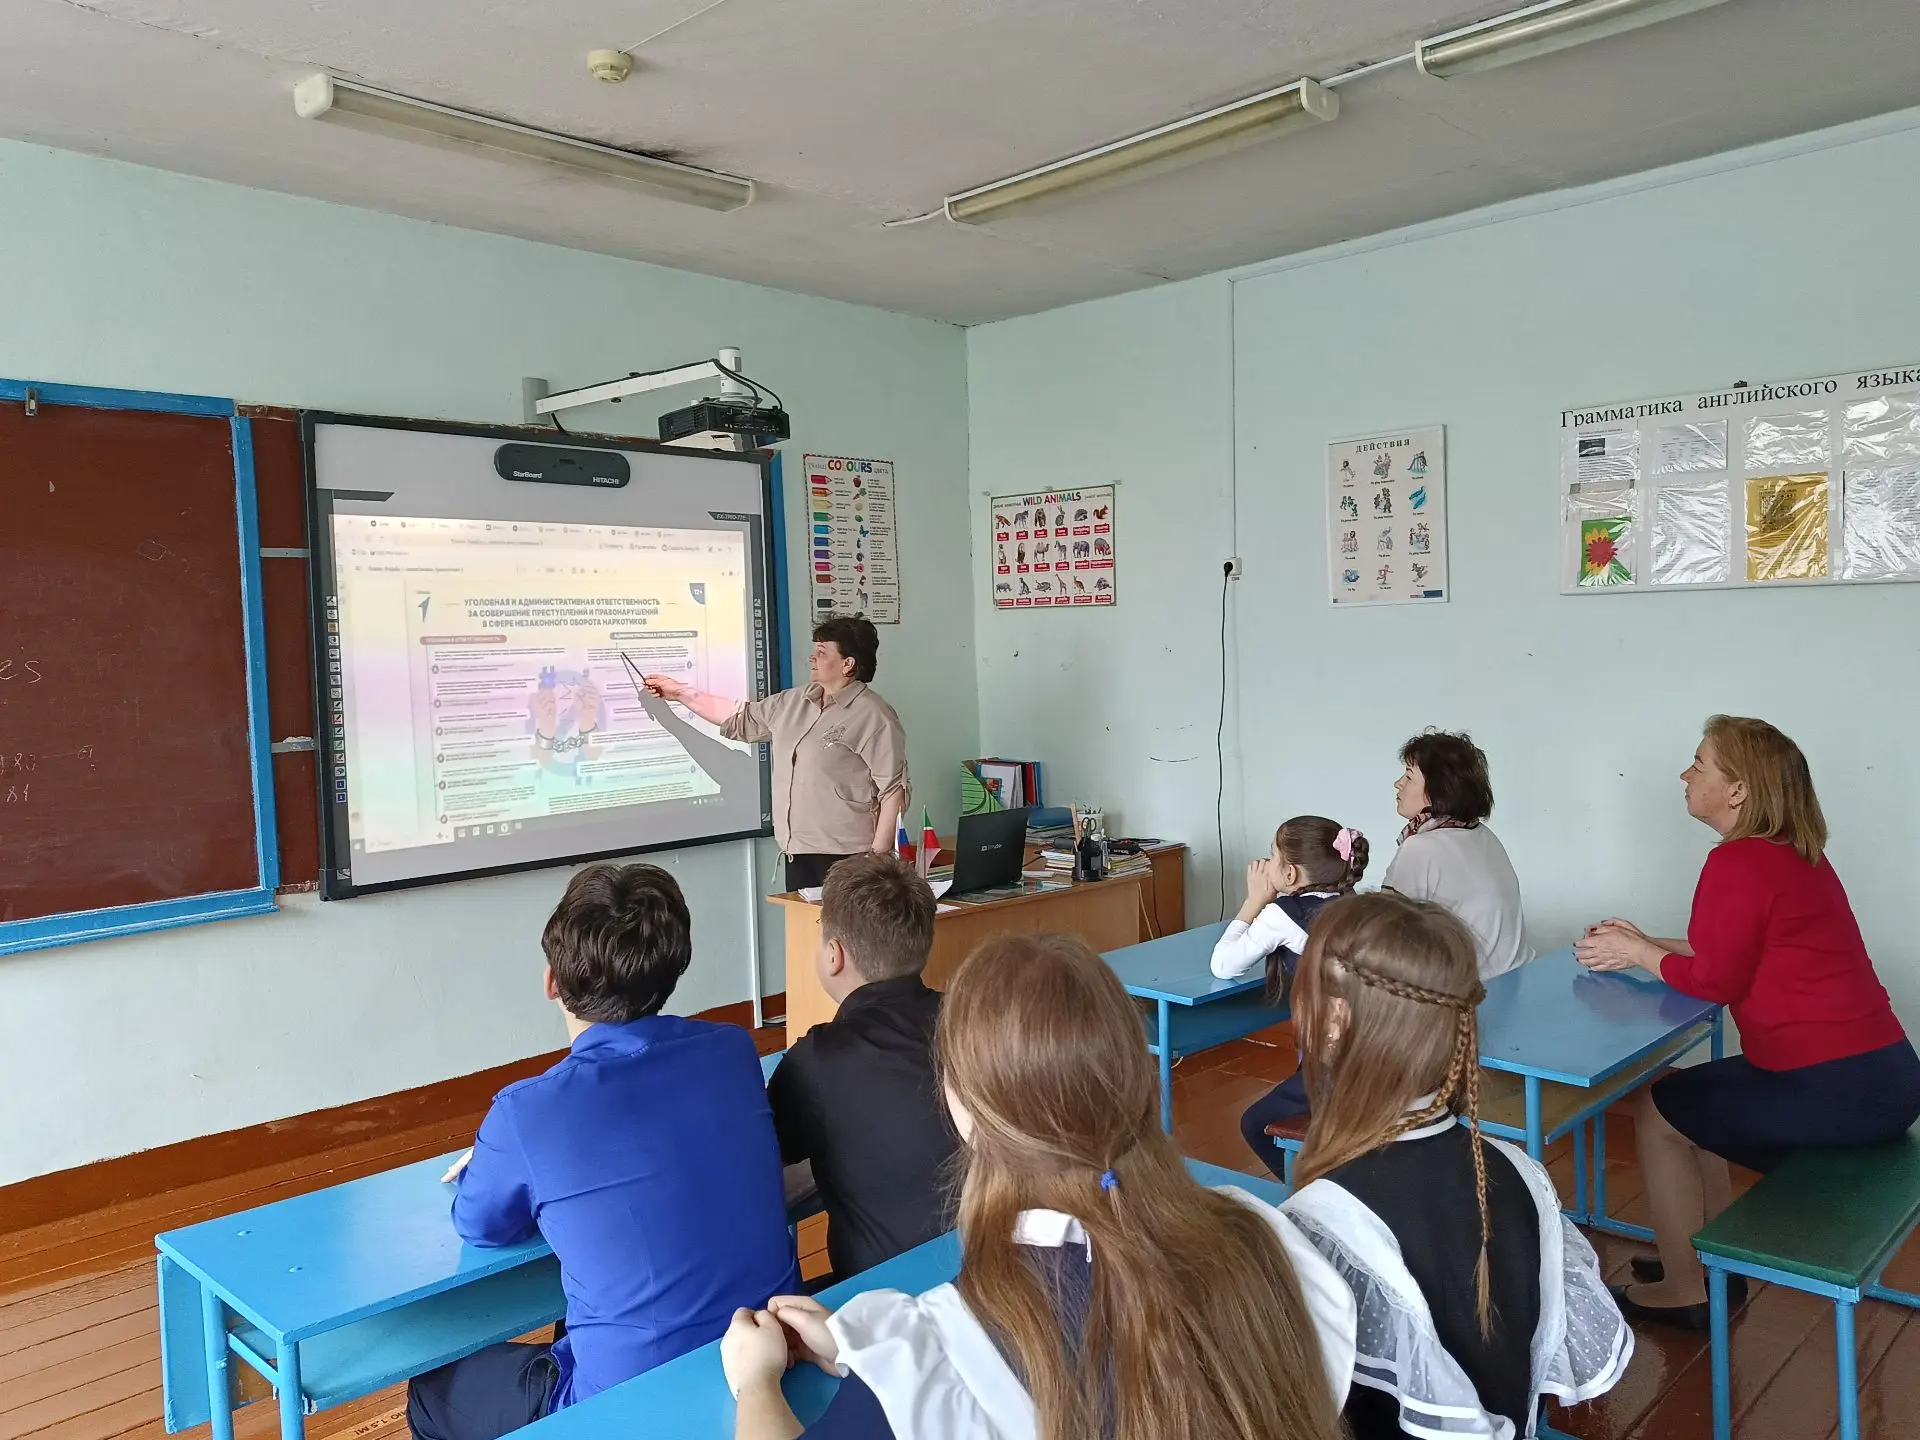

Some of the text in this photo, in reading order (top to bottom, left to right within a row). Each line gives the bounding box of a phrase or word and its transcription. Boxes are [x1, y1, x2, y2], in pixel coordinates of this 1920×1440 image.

[1560, 399, 1684, 428] Грамматика
[1697, 379, 1838, 410] английского
[827, 459, 873, 473] COLOURS
[513, 470, 543, 479] StarBoard
[592, 476, 620, 485] HITACHI
[1022, 495, 1043, 506] WILD
[1044, 492, 1082, 504] ANIMALS
[464, 598, 510, 607] УГОЛОВНАЯ
[518, 598, 595, 607] АДМИНИСТРАТИВНАЯ
[596, 598, 660, 606] ОТВЕТСТВЕННОСТЬ
[480, 609, 530, 617] СОВЕРШЕНИЕ
[515, 619, 568, 627] НЕЗАКОННОГО
[570, 618, 602, 626] ОБОРОТА
[603, 618, 648, 626] НАРКОТИКОВ
